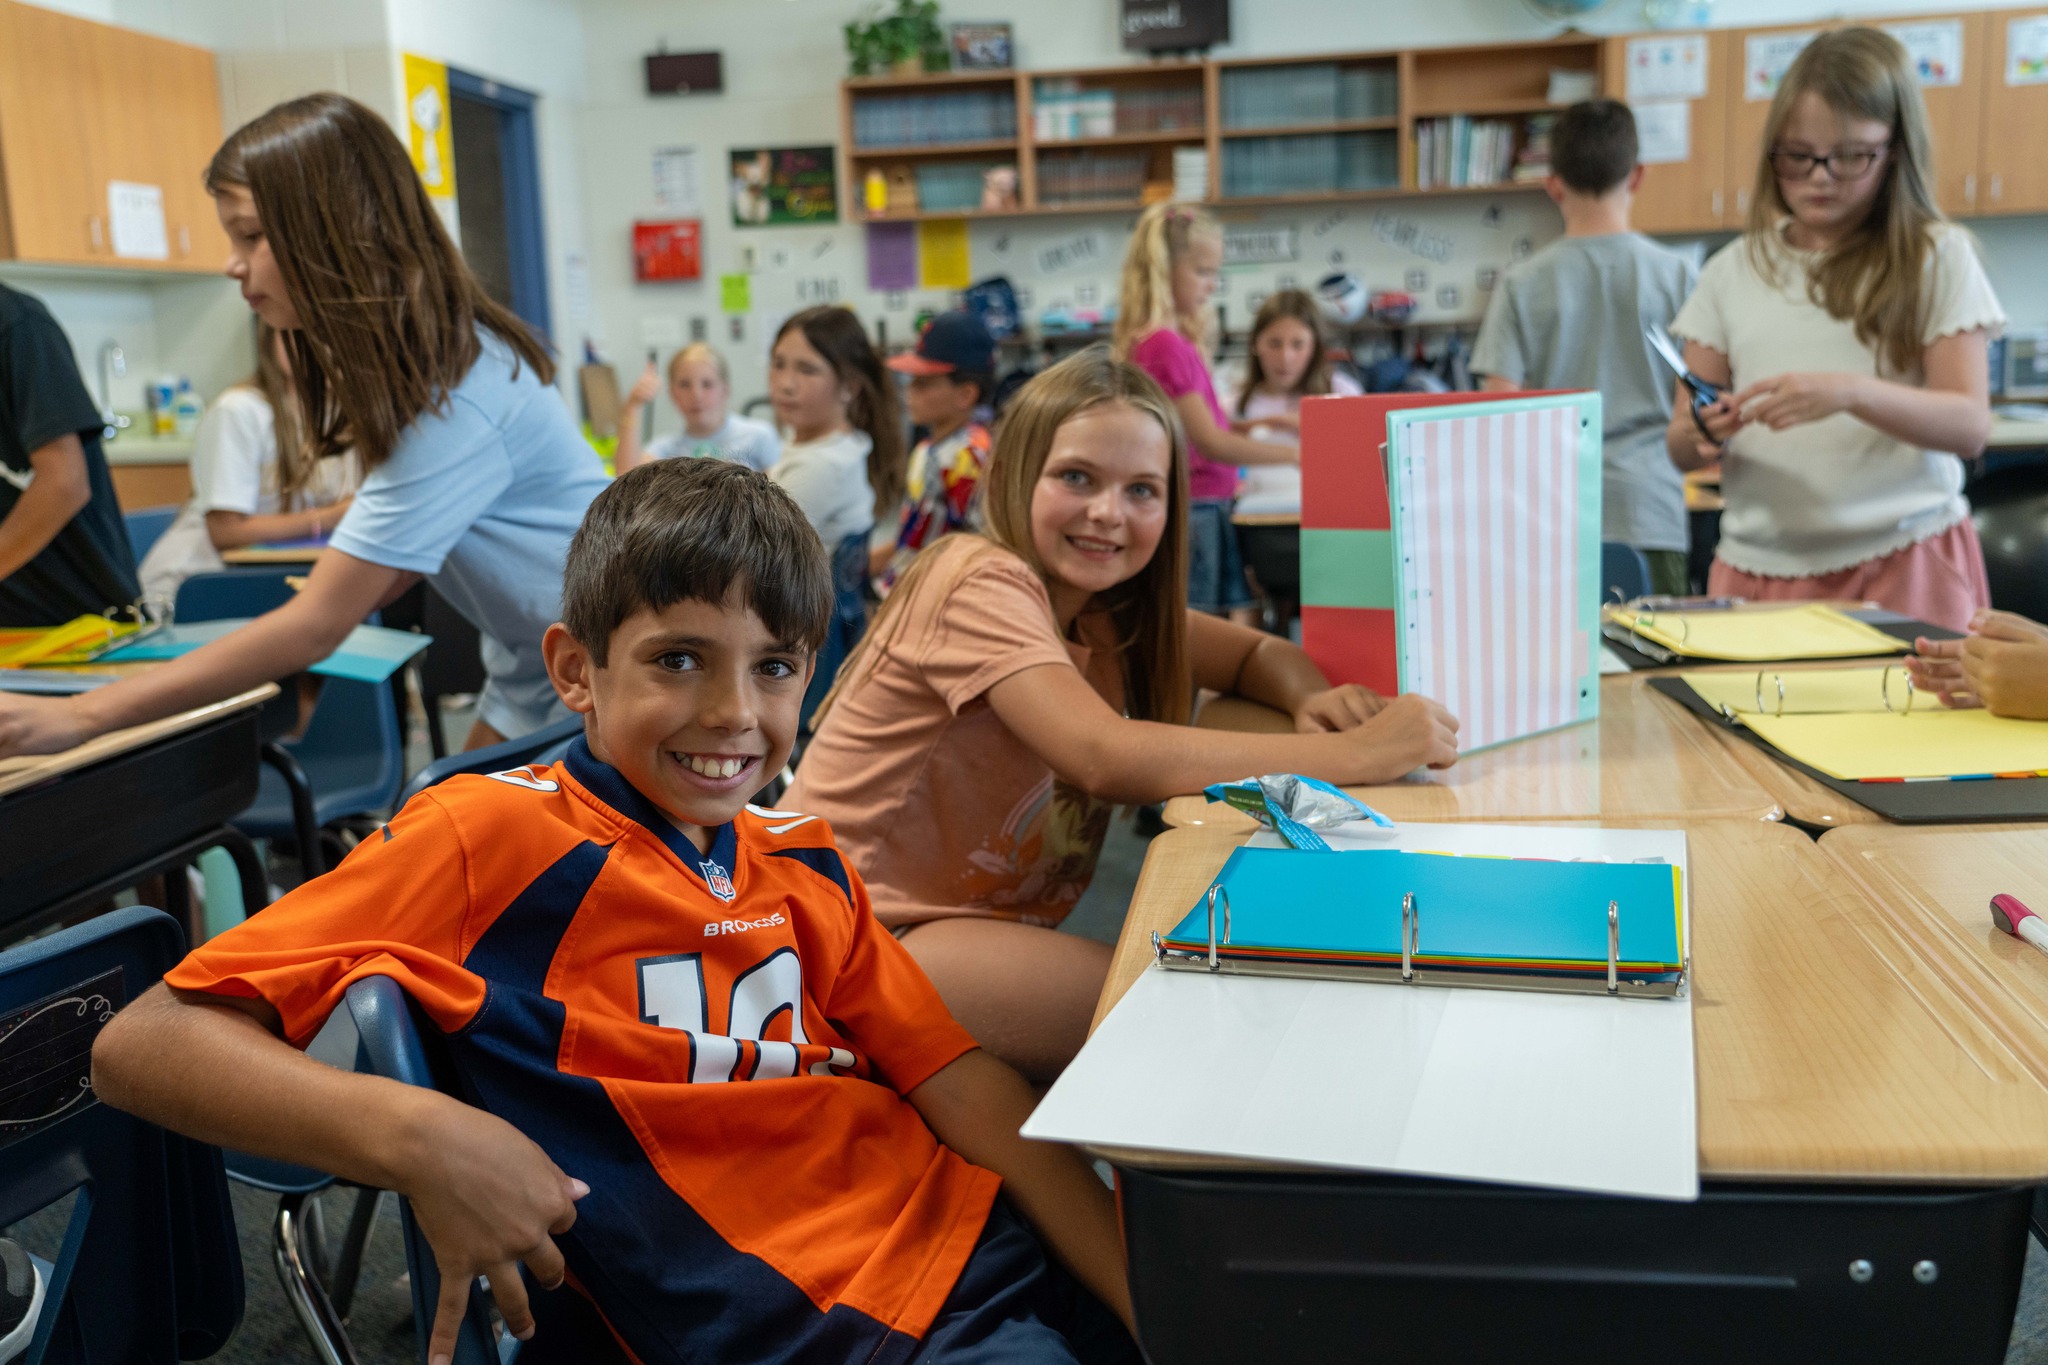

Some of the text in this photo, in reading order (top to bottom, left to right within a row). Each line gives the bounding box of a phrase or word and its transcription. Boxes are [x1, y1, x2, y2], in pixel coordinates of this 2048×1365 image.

[711, 875, 733, 895] NFL
[703, 912, 786, 937] BRONCOS
[636, 946, 857, 1084] 10
